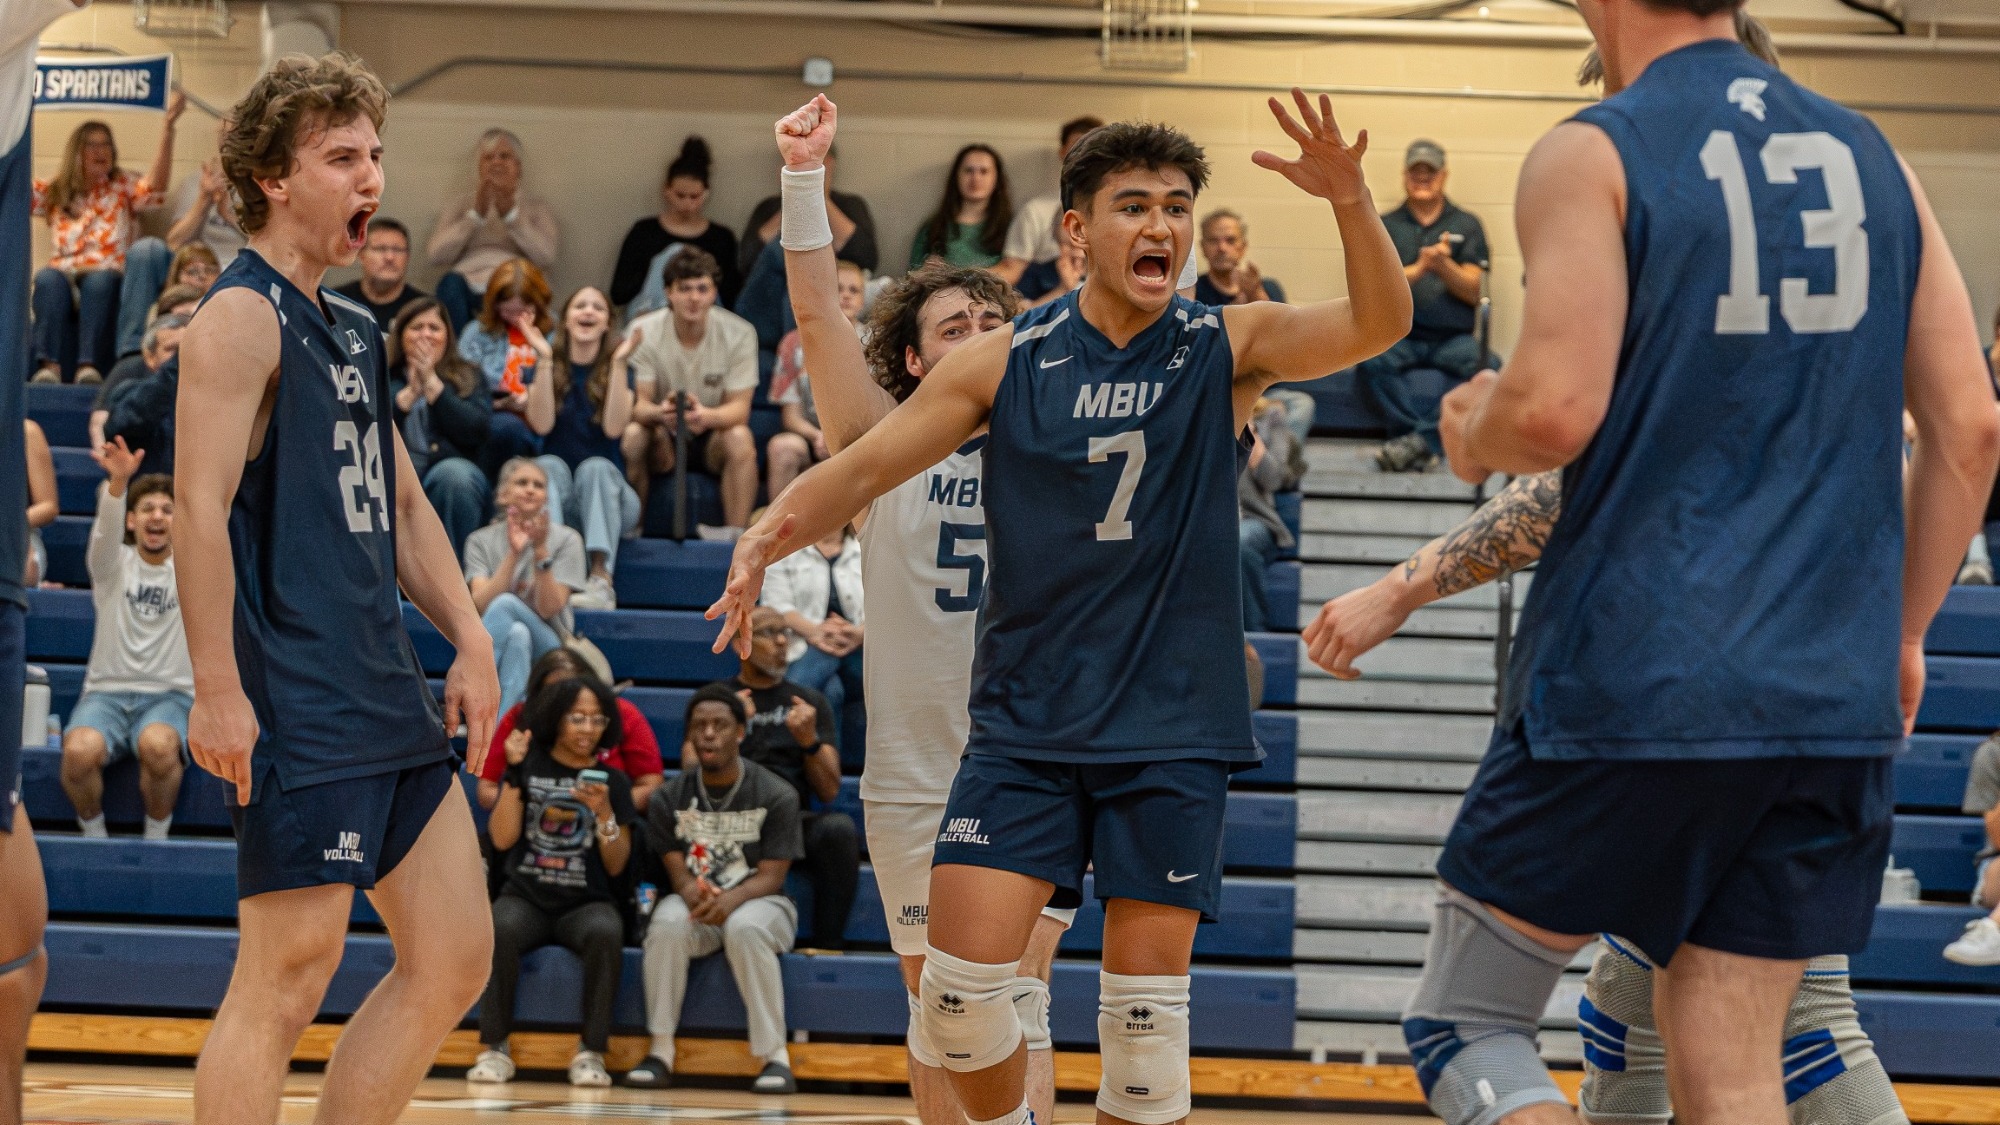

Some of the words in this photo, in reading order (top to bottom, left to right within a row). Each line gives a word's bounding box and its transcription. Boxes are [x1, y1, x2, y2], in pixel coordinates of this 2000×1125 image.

[45, 68, 151, 100] SPARTANS
[1699, 129, 1870, 334] 13
[1073, 382, 1164, 418] MBU
[334, 420, 391, 533] 24
[928, 473, 981, 508] MB
[1088, 430, 1147, 541] 7
[935, 520, 987, 612] 5
[946, 818, 981, 834] MBU
[896, 916, 929, 926] OLLEYB
[902, 905, 929, 918] MBU
